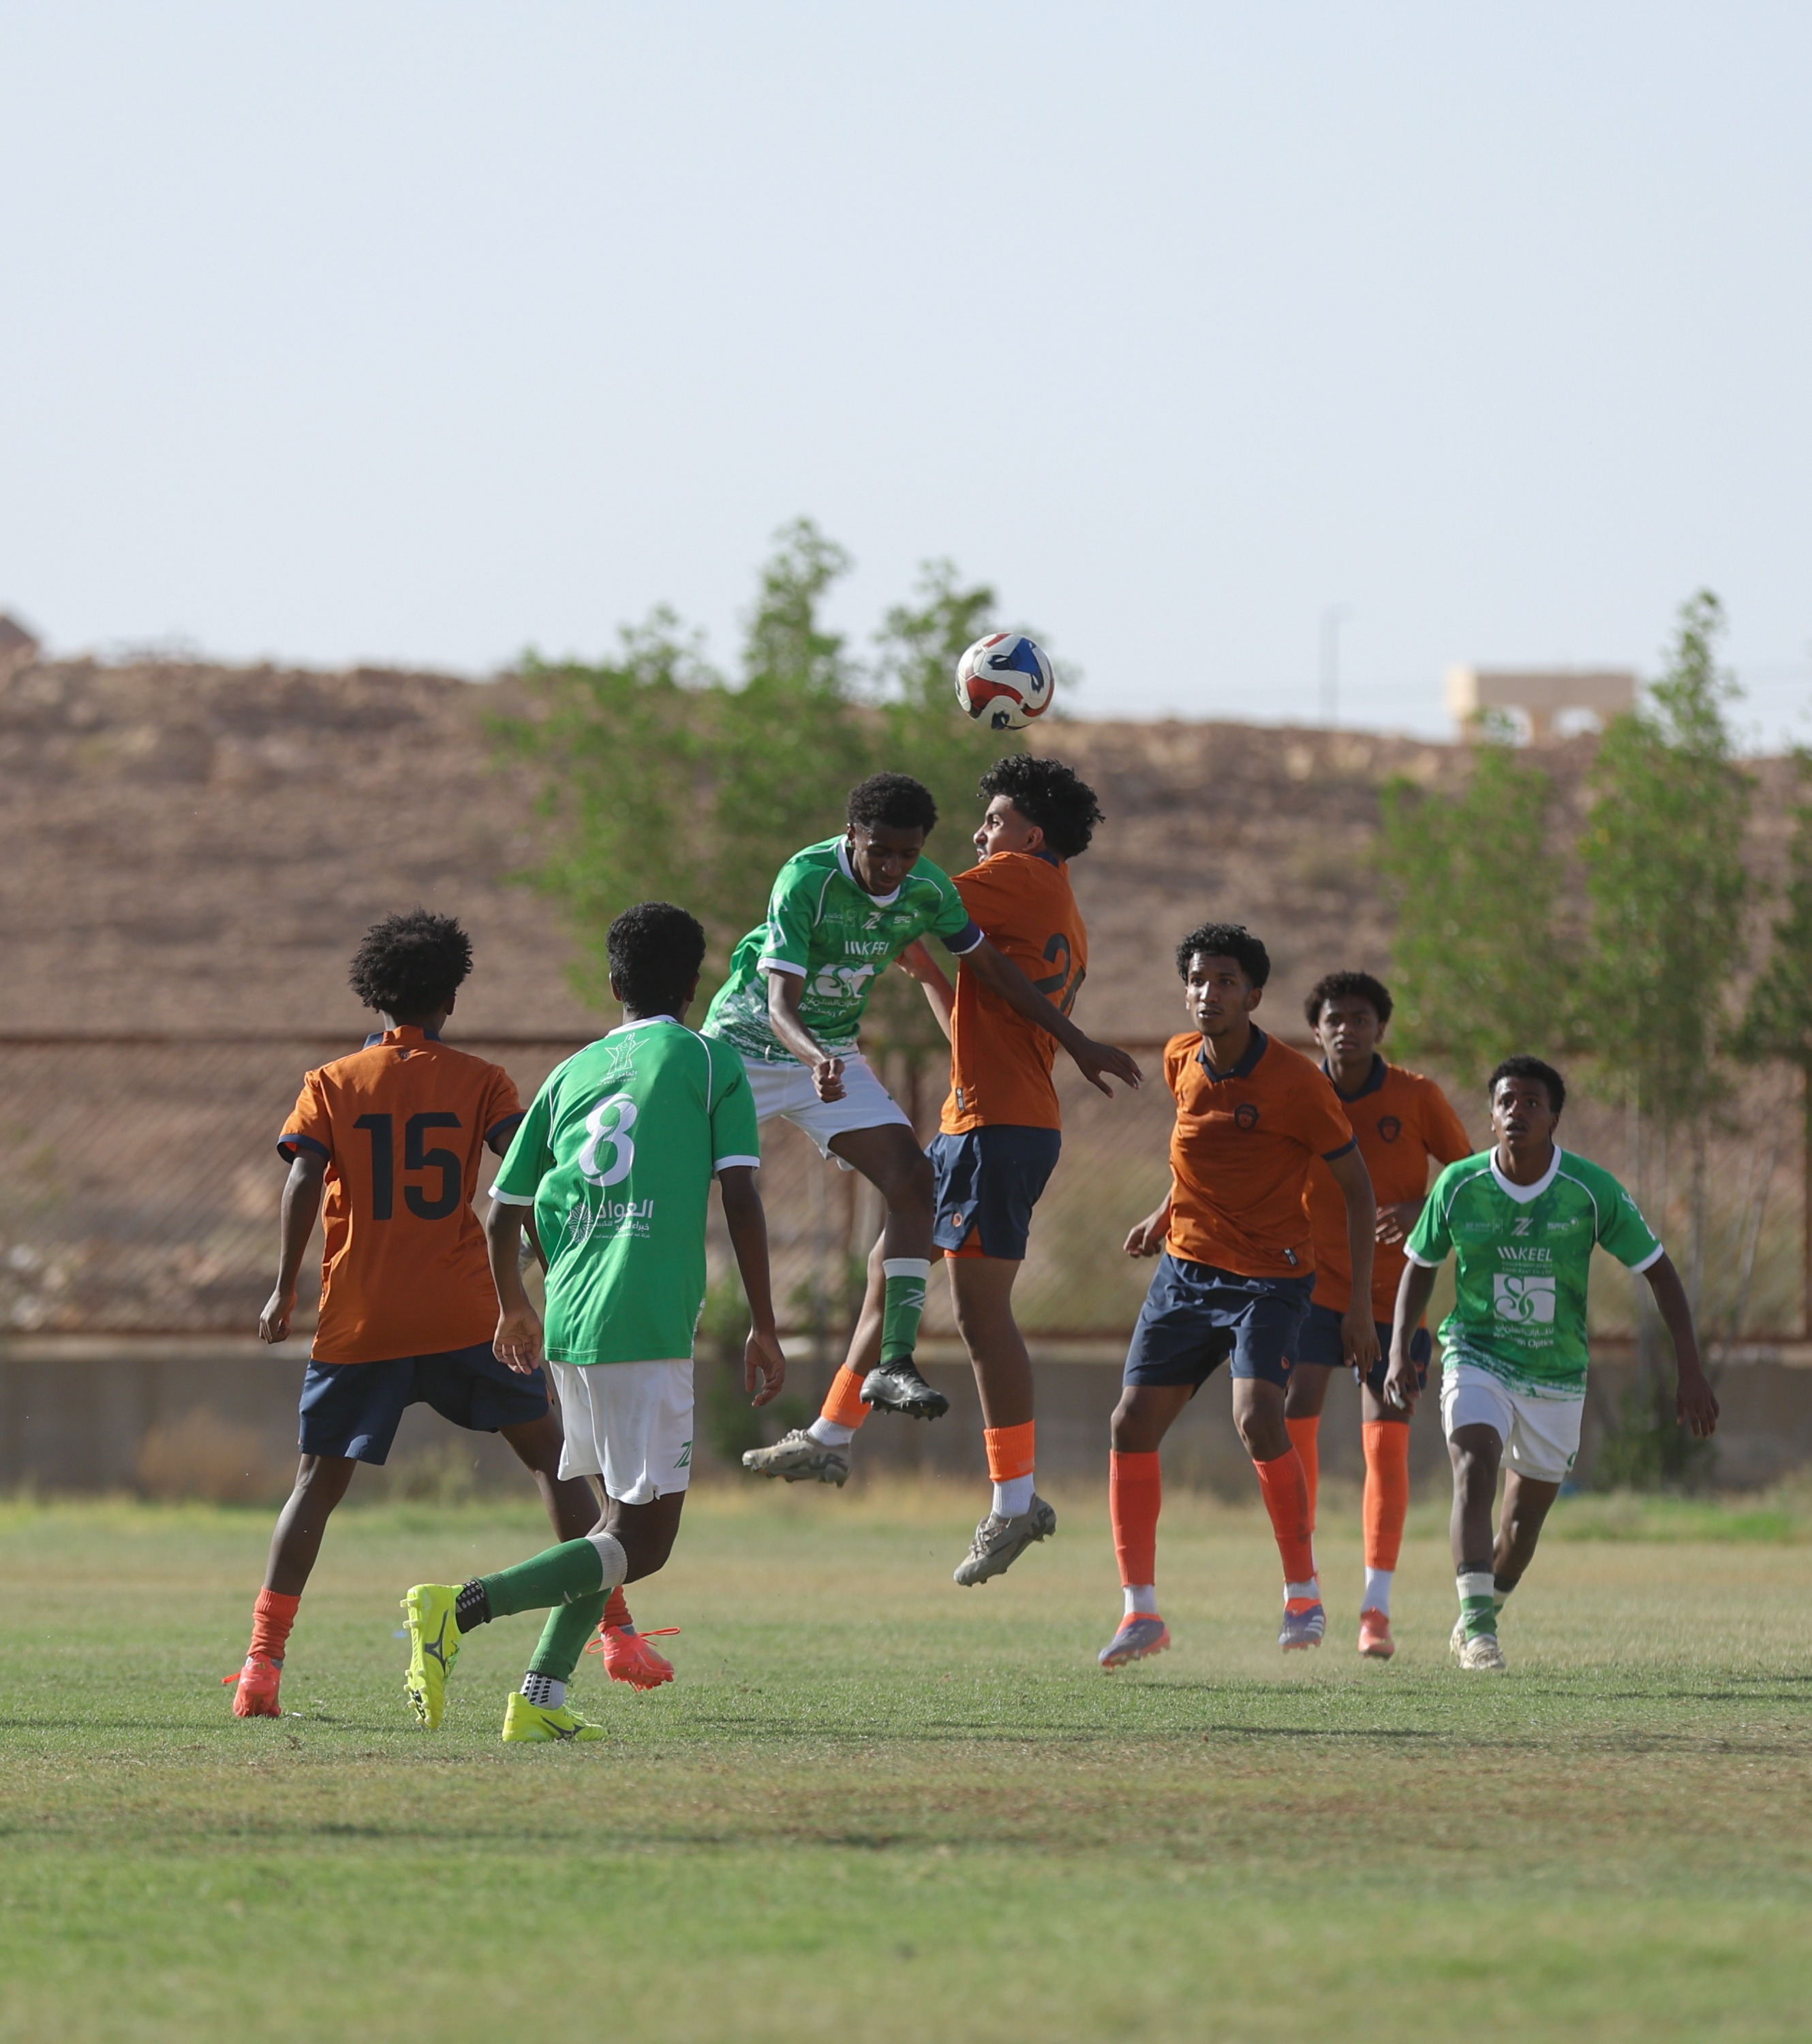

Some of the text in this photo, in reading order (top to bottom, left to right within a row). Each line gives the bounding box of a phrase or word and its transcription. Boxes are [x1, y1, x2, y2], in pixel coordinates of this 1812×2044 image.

[353, 1112, 463, 1220] 15
[579, 1092, 638, 1187] 8
[598, 1199, 654, 1224] العواد
[1518, 1246, 1553, 1262] KEEL
